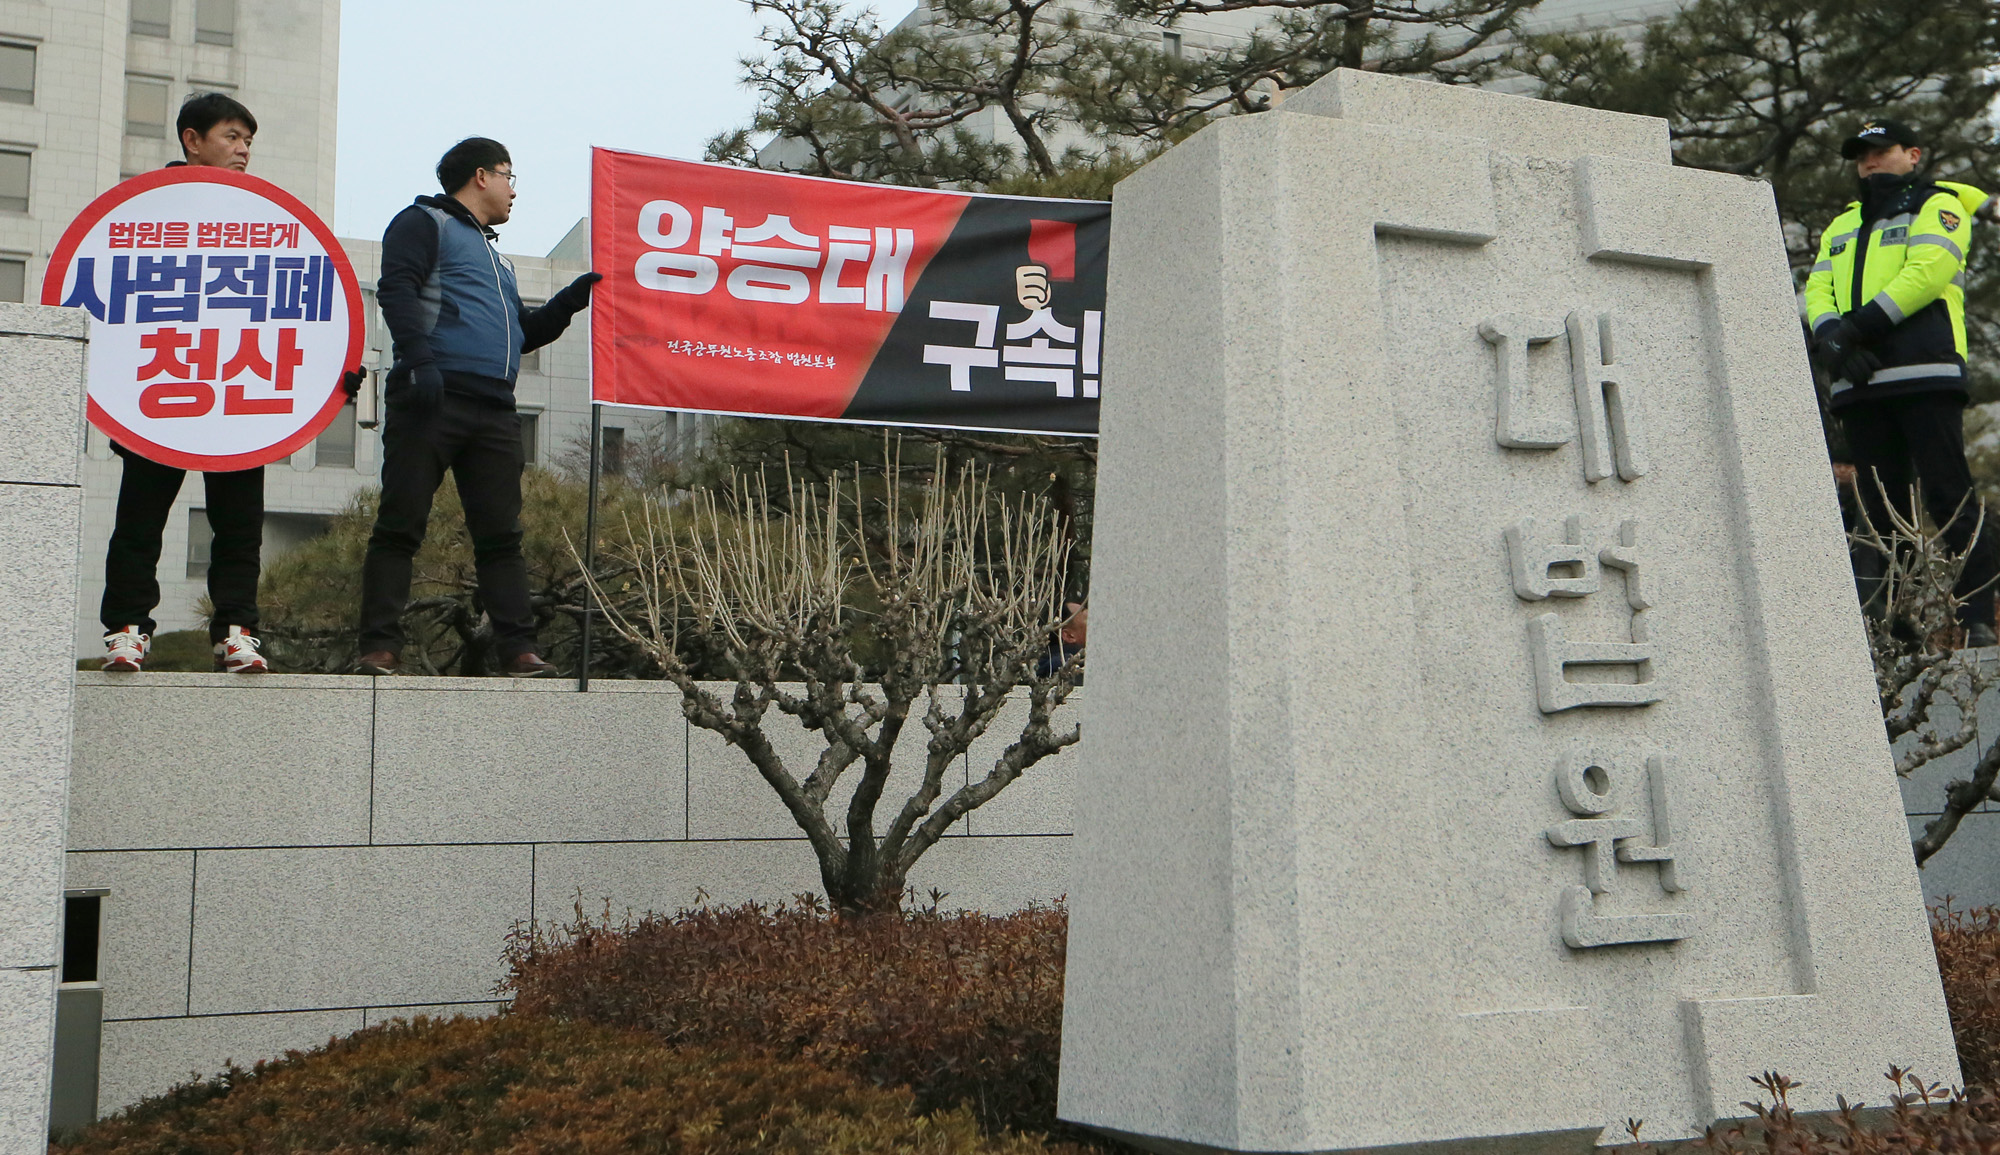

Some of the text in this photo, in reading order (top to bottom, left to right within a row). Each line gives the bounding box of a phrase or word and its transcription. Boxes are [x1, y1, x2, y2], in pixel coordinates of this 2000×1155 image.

[108, 221, 300, 249] 법원을 법원답게
[634, 199, 914, 313] 양승태
[60, 254, 335, 324] 사법적폐
[136, 327, 303, 419] 청산
[667, 340, 837, 370] 전국공무원노동조합 법원본부
[922, 300, 1102, 398] 구속!
[1477, 306, 1697, 950] 대법원
